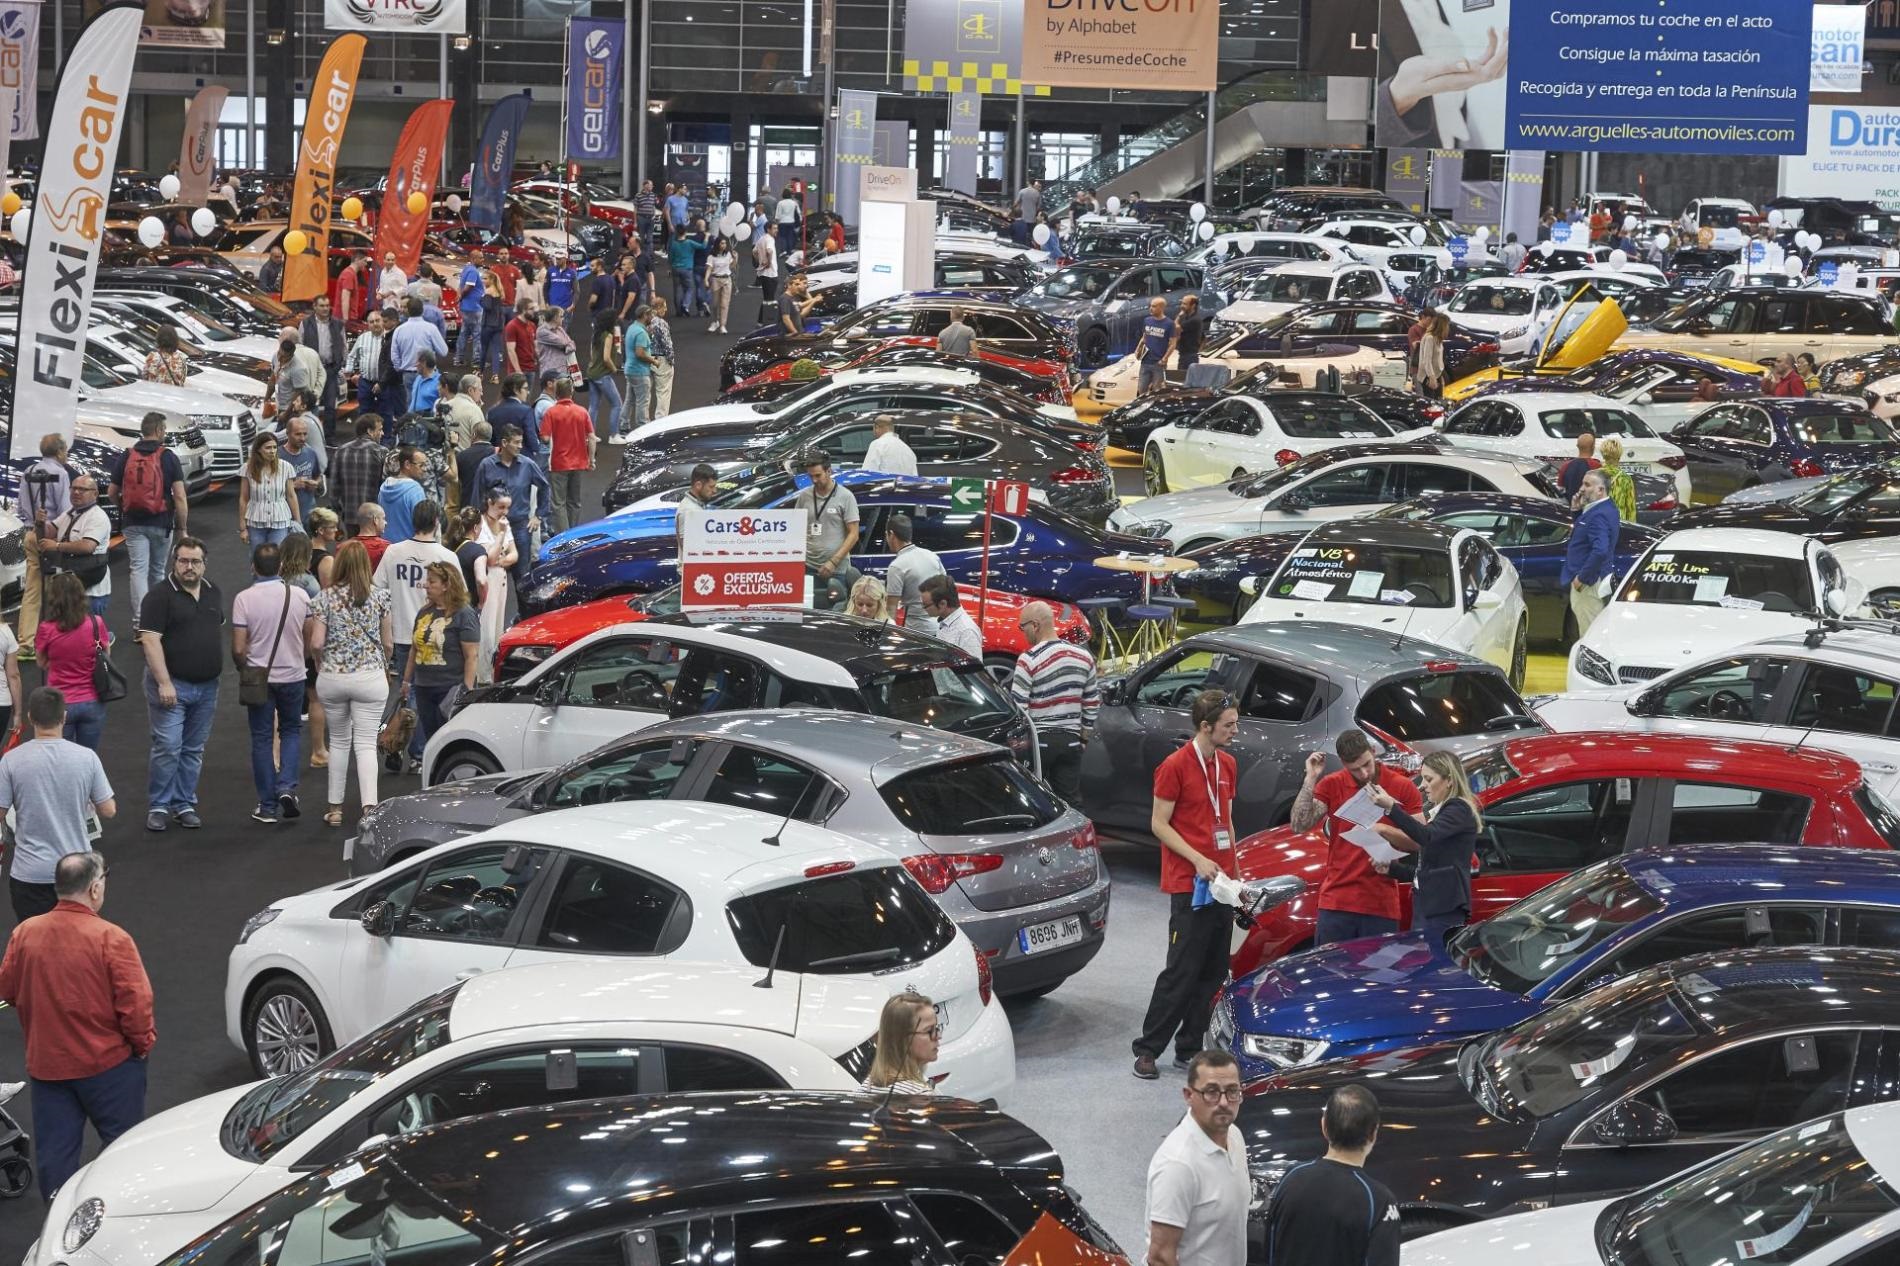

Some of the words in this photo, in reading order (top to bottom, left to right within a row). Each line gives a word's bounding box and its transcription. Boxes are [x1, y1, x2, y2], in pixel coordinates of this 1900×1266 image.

[1047, 17, 1064, 36] by
[1068, 18, 1136, 36] Alphabet
[1550, 12, 1636, 27] Compramos
[1640, 14, 1654, 26] tu
[1658, 14, 1700, 27] coche
[1704, 16, 1722, 27] en
[1726, 15, 1738, 28] el
[1742, 16, 1773, 28] acto
[1054, 50, 1187, 67] #PresumedeCoche
[1560, 46, 1624, 63] Consigue
[1629, 48, 1640, 61] la
[1645, 48, 1698, 62] máxima
[1703, 49, 1760, 62] tasación
[1520, 81, 1583, 98] Recogida
[1587, 85, 1596, 97] y
[1600, 84, 1652, 100] entrega
[1657, 87, 1674, 97] en
[1679, 85, 1710, 98] toda
[1716, 85, 1726, 98] la
[1731, 86, 1797, 99] Península
[323, 69, 351, 134] car
[73, 75, 118, 180] car
[1519, 124, 1795, 142] www.arguelles-automoviles.com
[33, 241, 88, 390] Flexi
[705, 516, 786, 535] Cars&Cars
[1320, 549, 1342, 559] V8
[1291, 558, 1344, 568] Nacional
[1682, 564, 1710, 574] Line
[724, 572, 773, 583] OFERTAS
[724, 582, 794, 595] EXCLUSIVAS
